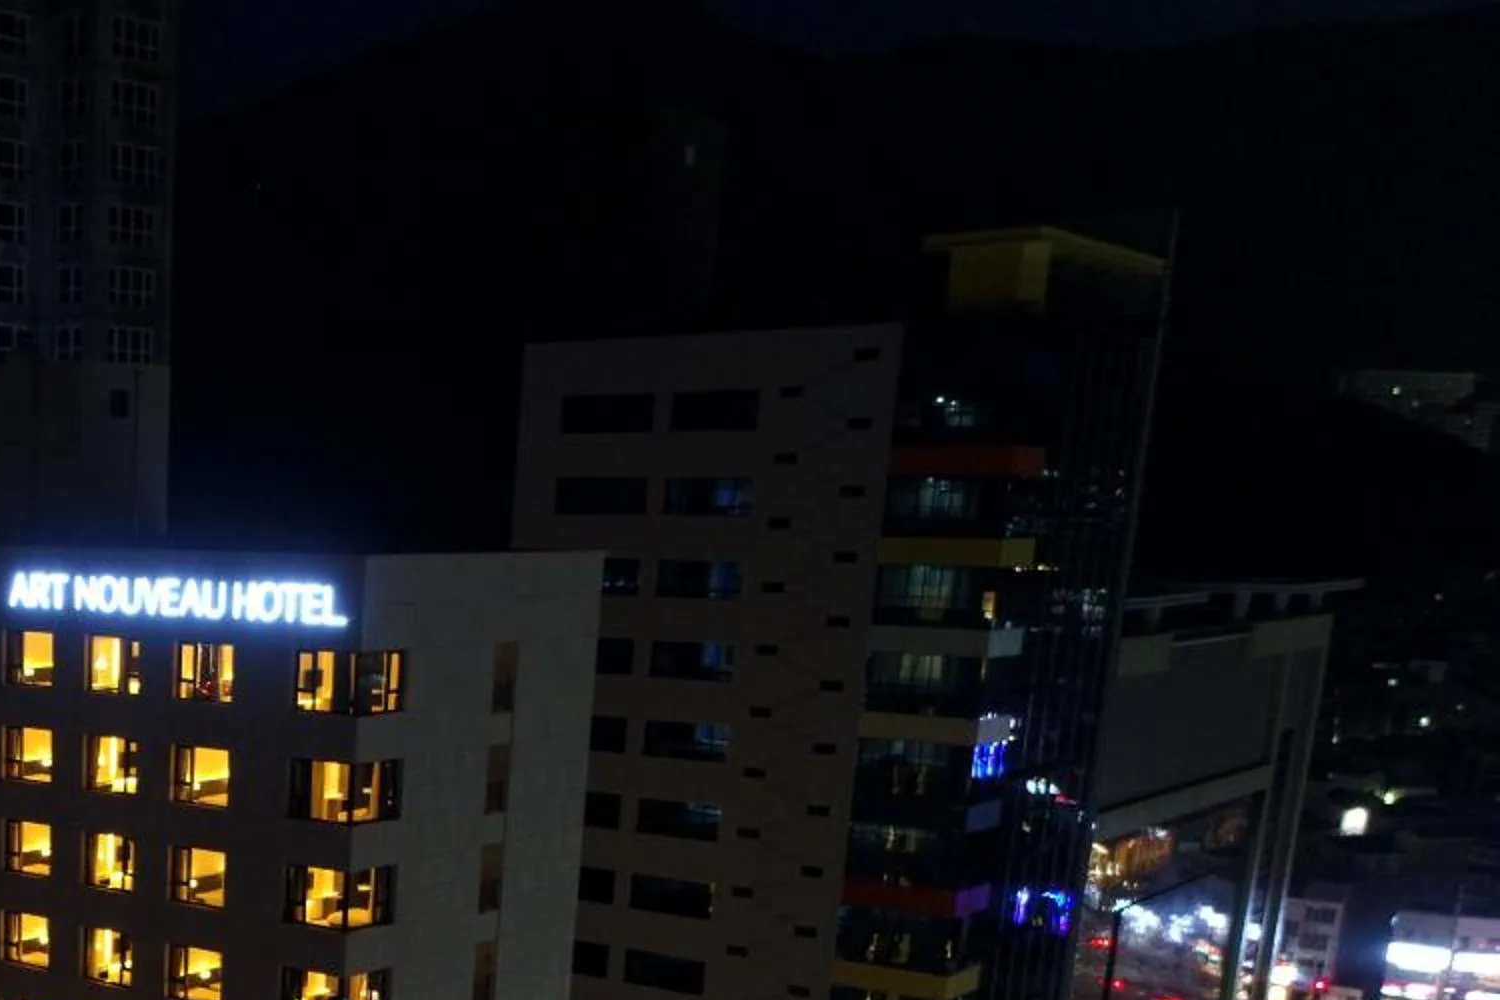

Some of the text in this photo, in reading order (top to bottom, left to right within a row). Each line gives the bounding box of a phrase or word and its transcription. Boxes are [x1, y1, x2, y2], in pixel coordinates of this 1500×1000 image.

[8, 571, 348, 627] ART NOUVEAU HOTEL
